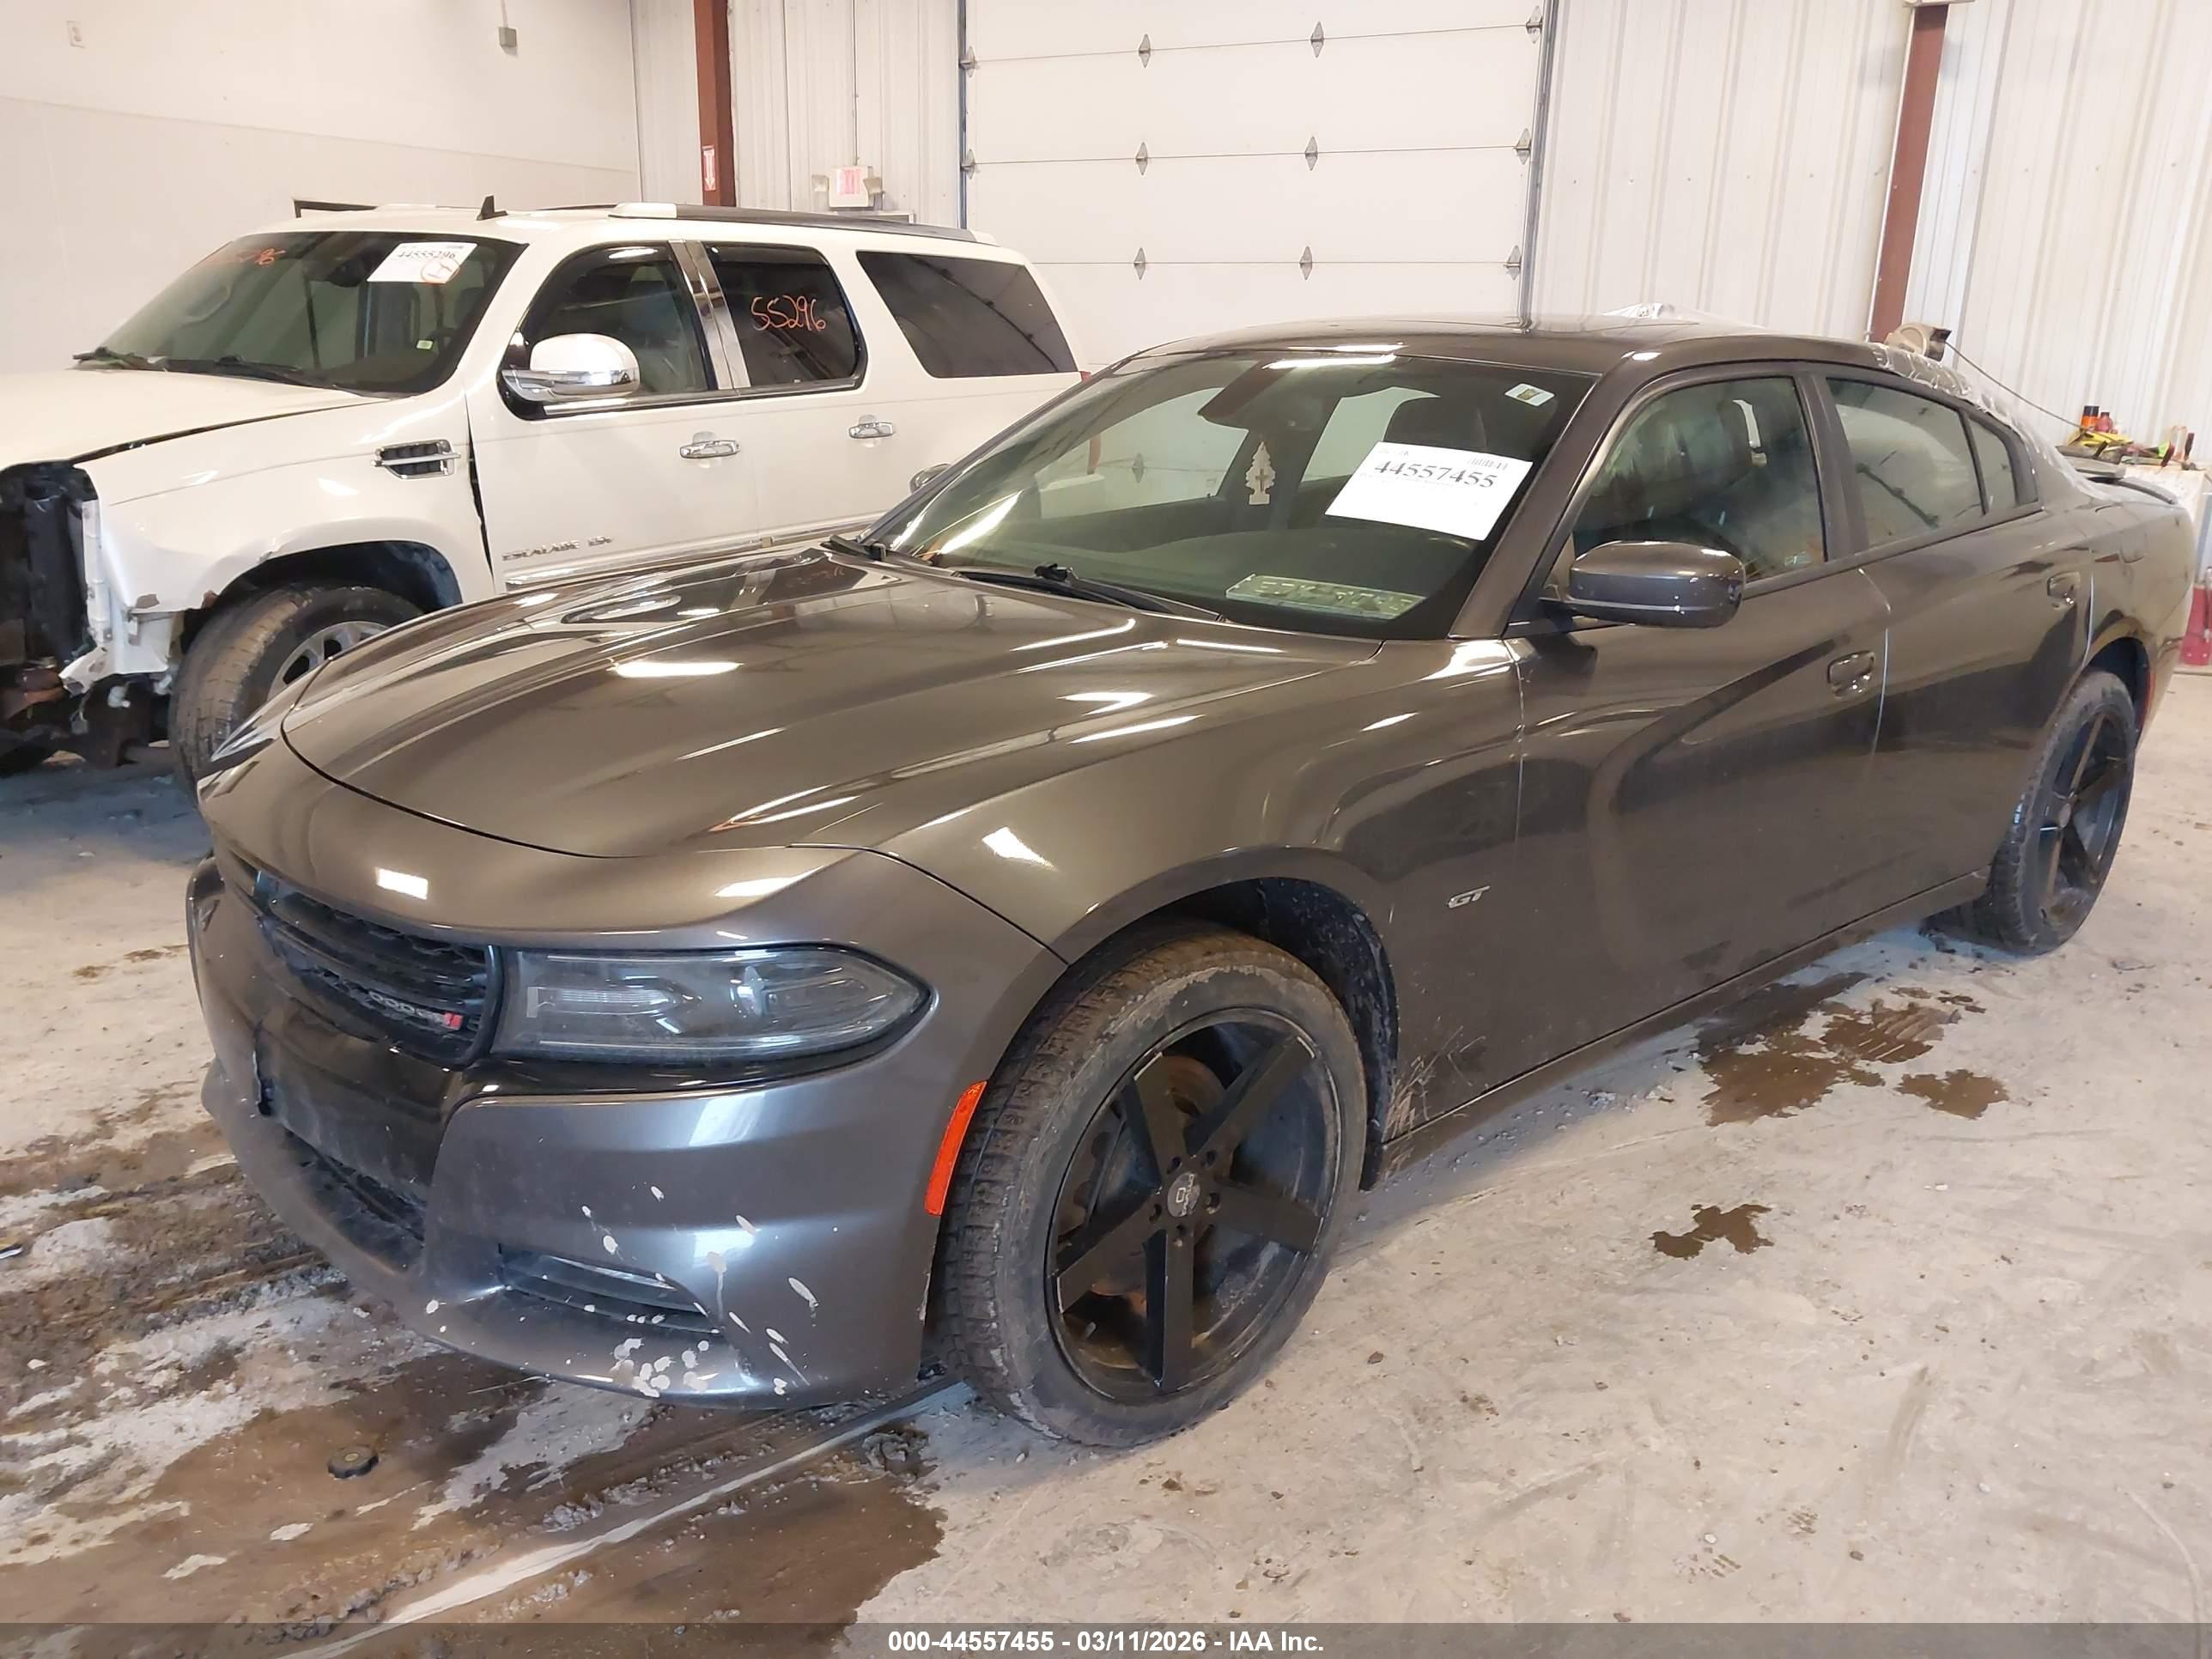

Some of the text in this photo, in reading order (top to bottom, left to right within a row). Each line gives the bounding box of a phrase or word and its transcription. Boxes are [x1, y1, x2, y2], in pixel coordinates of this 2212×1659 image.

[750, 295, 826, 332] 55296
[1375, 460, 1498, 489] 44557455
[1448, 885, 1491, 908] GT
